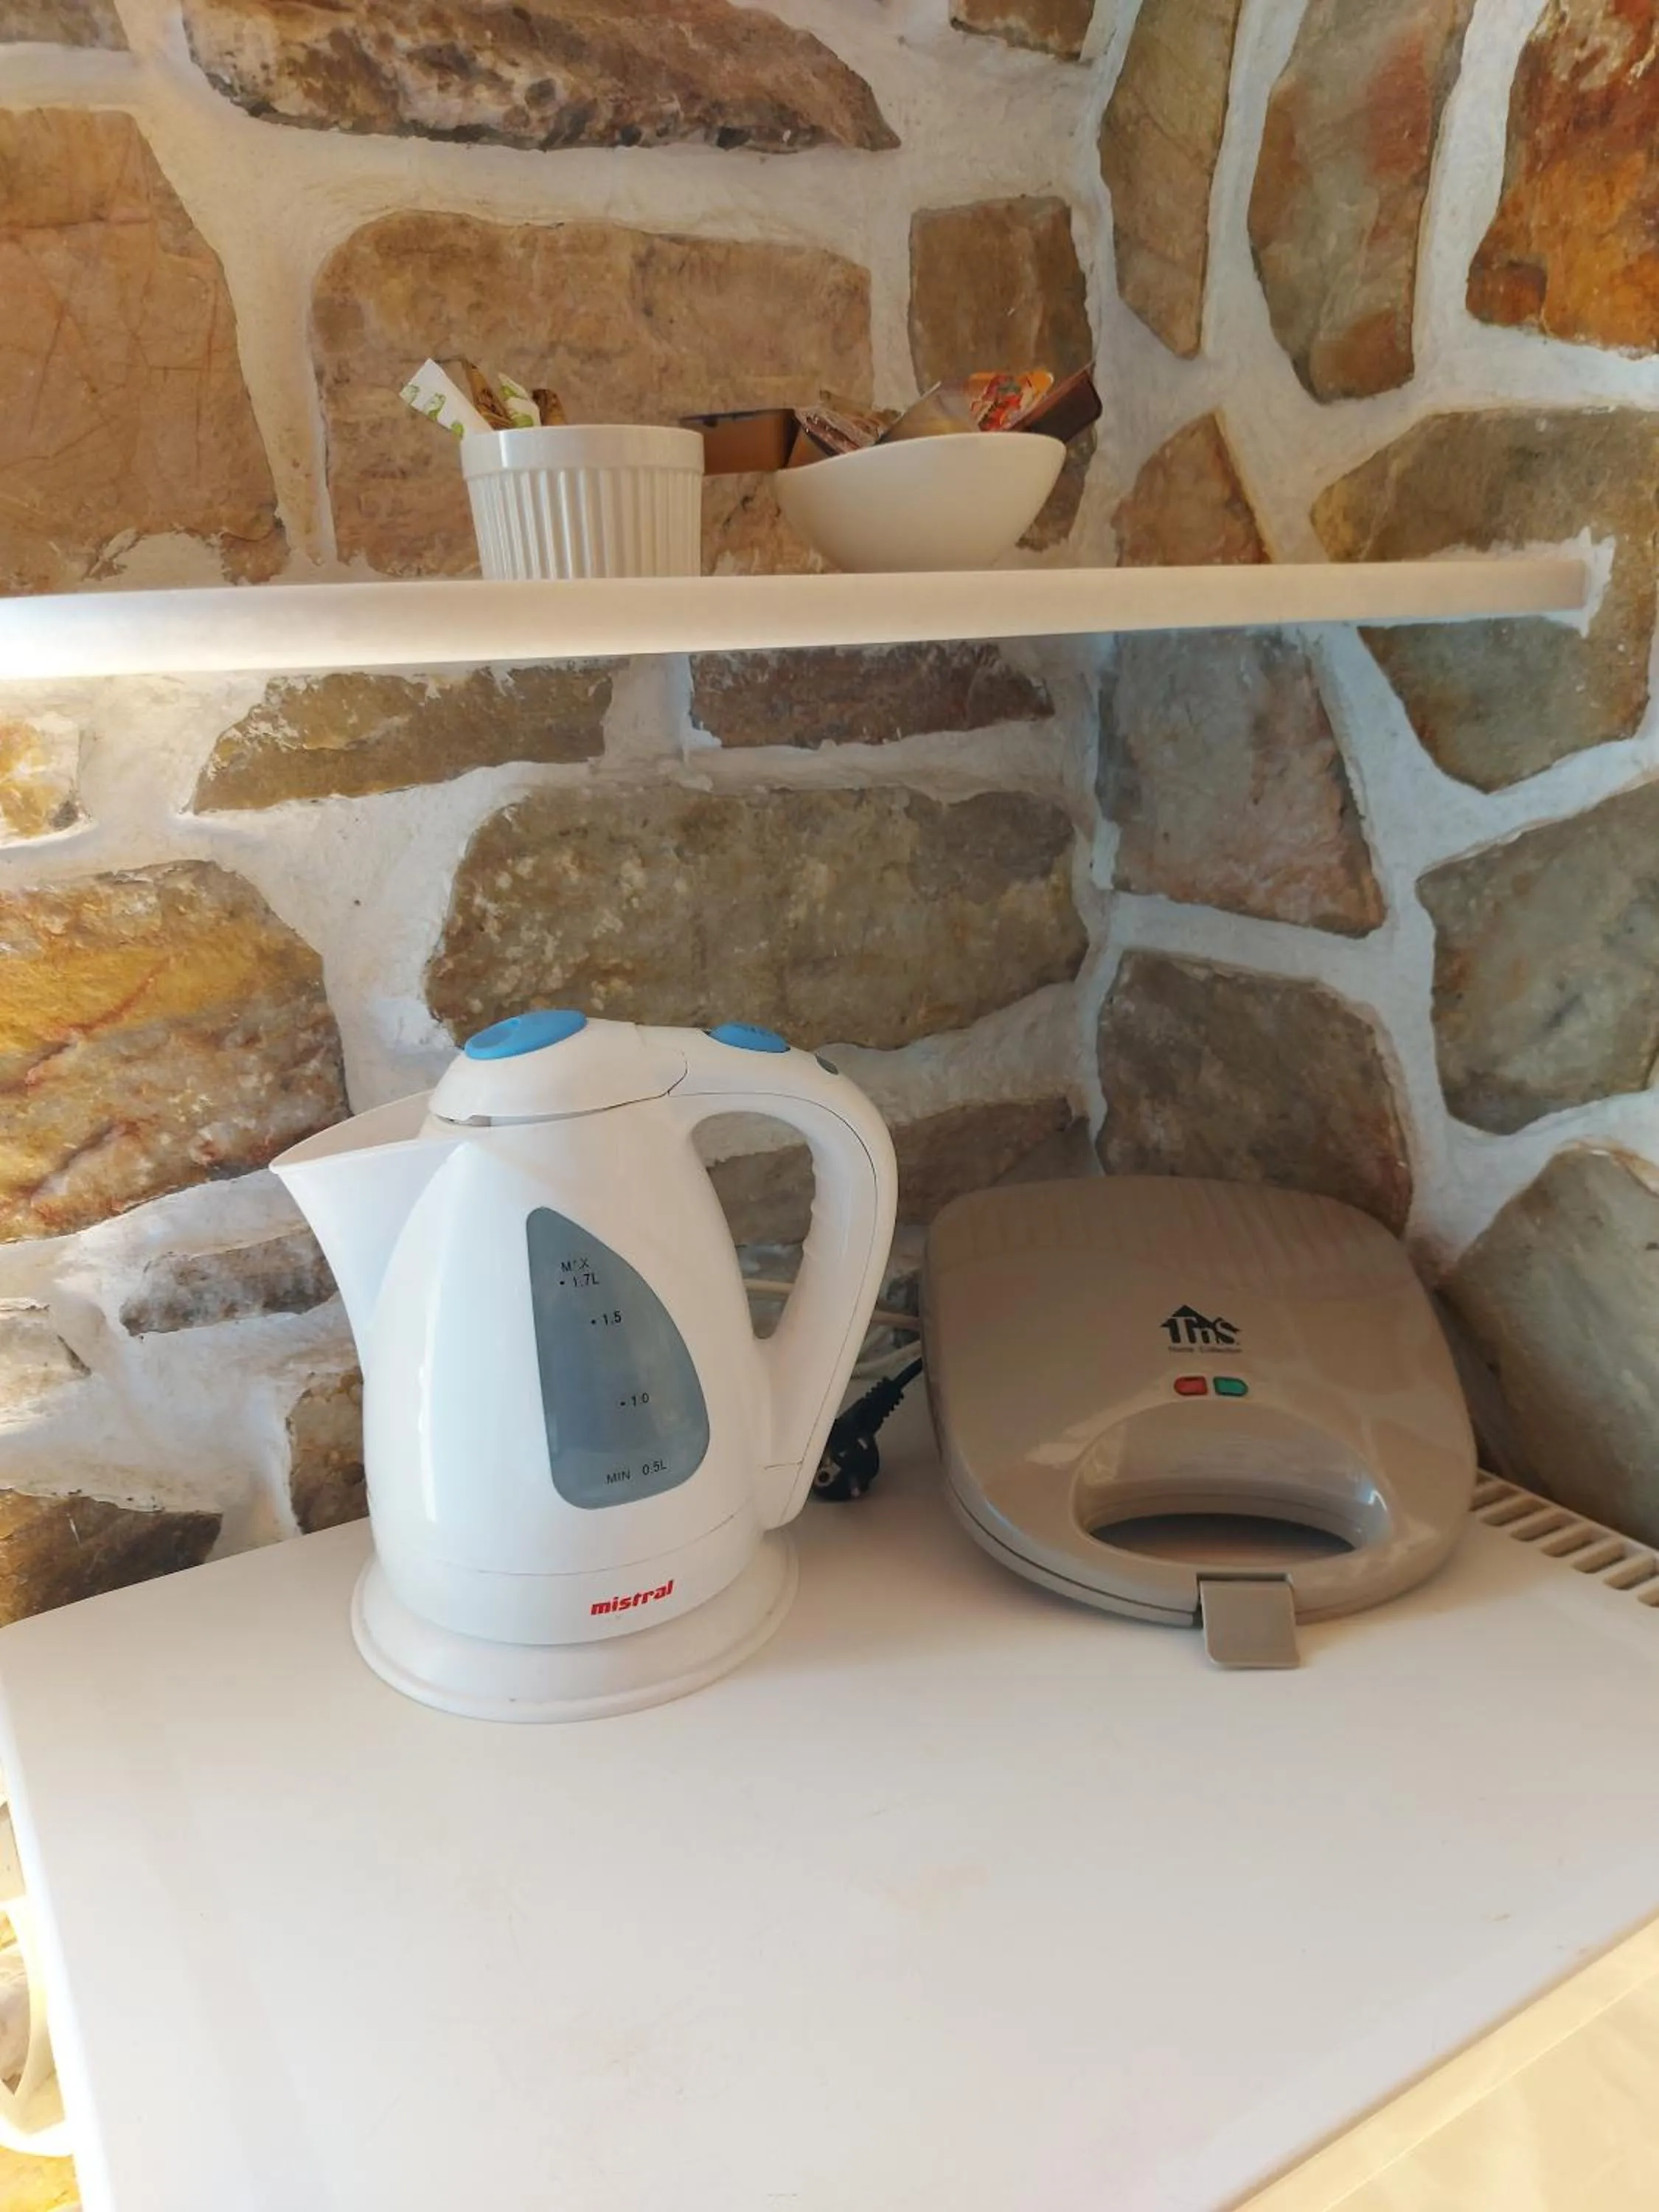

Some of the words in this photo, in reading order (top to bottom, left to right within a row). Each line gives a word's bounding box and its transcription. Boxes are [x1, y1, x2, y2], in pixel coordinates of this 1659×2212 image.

[561, 1256, 590, 1273] MX
[602, 1310, 622, 1326] 1.5
[607, 1469, 630, 1484] MIN
[642, 1458, 667, 1475] 0.5L
[591, 1579, 673, 1615] mistral
